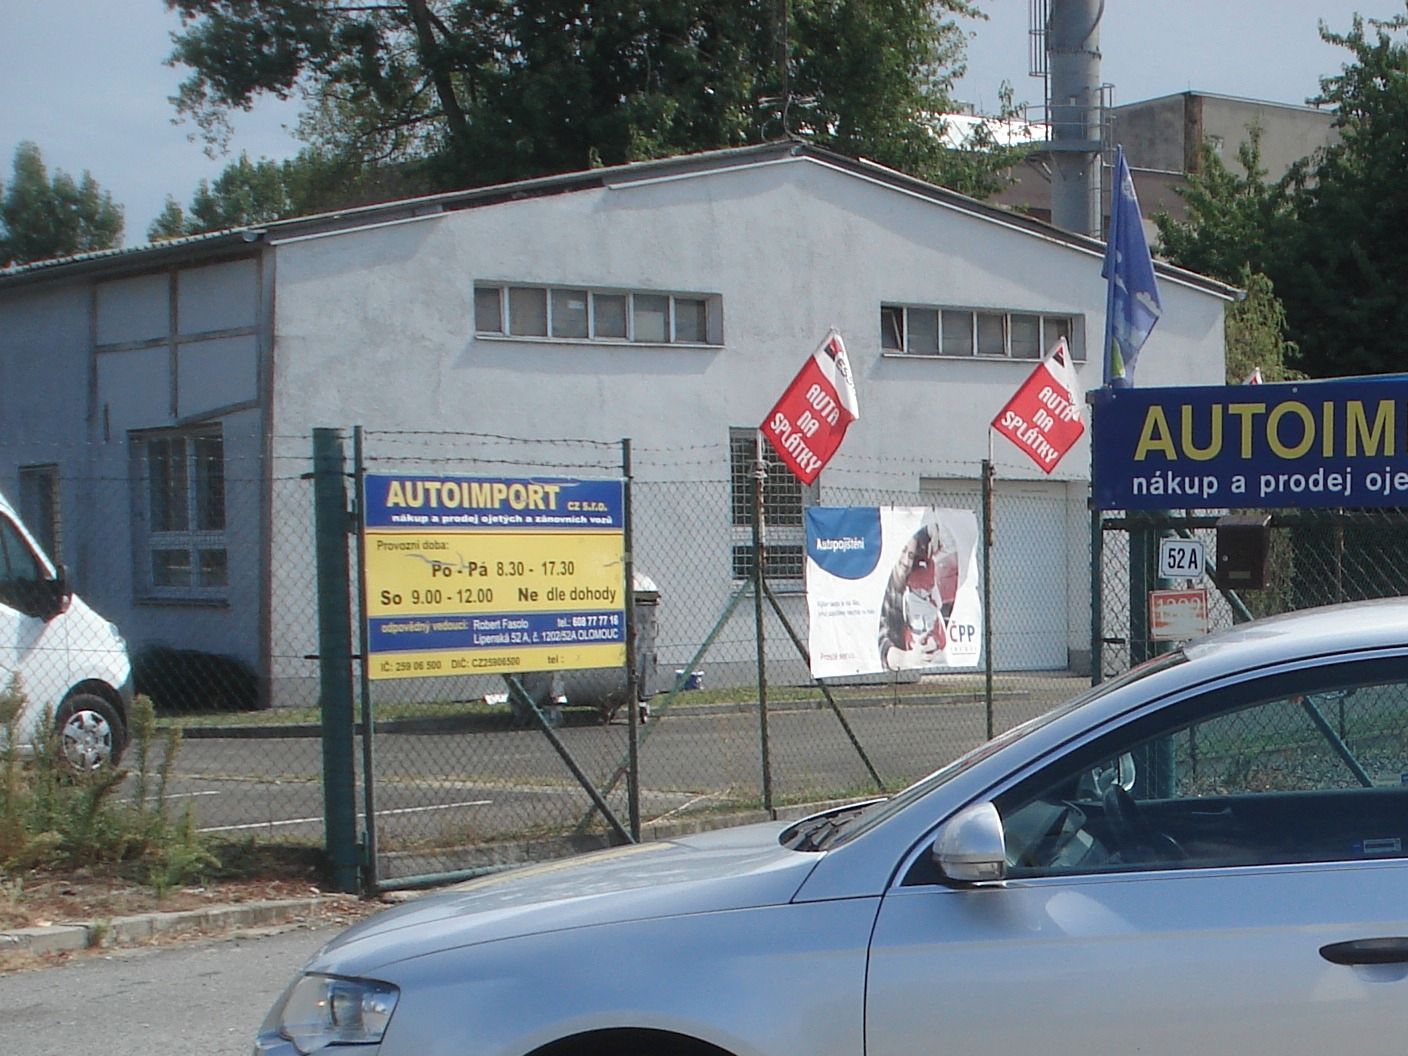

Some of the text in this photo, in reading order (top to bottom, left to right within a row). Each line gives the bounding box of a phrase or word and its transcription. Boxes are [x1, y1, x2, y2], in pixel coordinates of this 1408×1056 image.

[805, 384, 840, 426] AUTA
[1038, 386, 1073, 422] AUTA
[797, 410, 820, 438] NA
[1033, 408, 1054, 433] NA
[770, 412, 823, 474] SPLÁTKY
[1001, 411, 1058, 463] SPLÁTKY
[1132, 470, 1218, 499] nákup
[1231, 474, 1246, 494] a
[1260, 467, 1353, 498] prodej
[386, 481, 560, 511] AUTOIMPORT
[583, 502, 608, 512] s.r.o.
[391, 514, 613, 525] nákup a prodej ojetých a zánovních vozů
[432, 560, 452, 577] Po
[468, 561, 488, 577] Pá
[496, 561, 524, 576] 8.30
[541, 560, 575, 576] 17.30
[1167, 547, 1198, 570] 52 A
[381, 590, 402, 606] So
[412, 589, 442, 605] 9.00
[457, 588, 493, 604] 12.00
[518, 586, 617, 604] Ne dle dohody
[473, 619, 501, 631] Robert
[587, 616, 597, 627] 77
[598, 615, 609, 626] 77
[949, 620, 976, 643] ČPP
[578, 628, 619, 641] OLOMOUC
